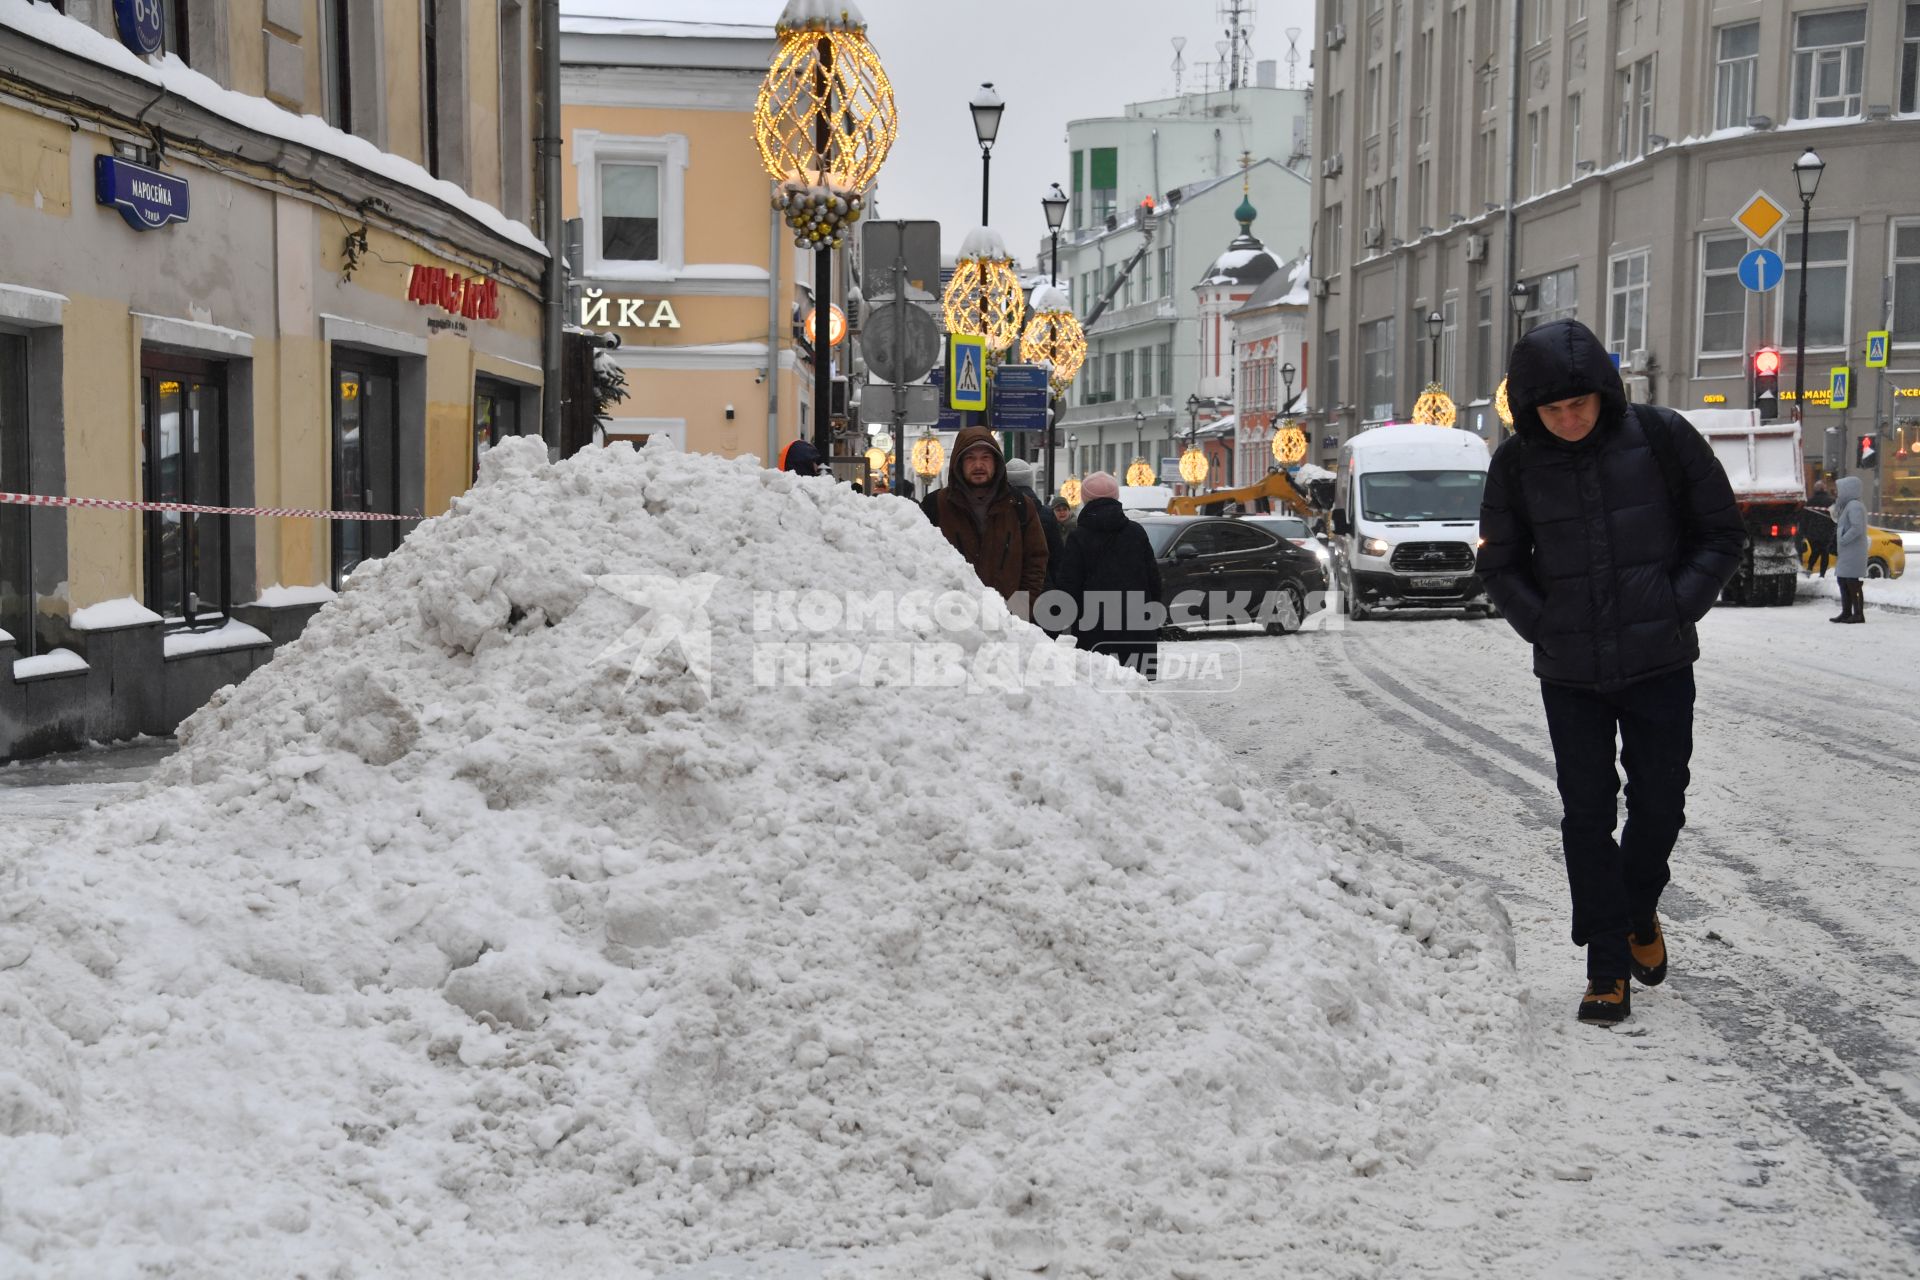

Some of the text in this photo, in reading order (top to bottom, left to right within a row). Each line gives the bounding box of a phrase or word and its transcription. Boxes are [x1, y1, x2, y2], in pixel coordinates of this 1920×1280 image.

[132, 179, 173, 206] МАРОСЕЙКА
[144, 208, 160, 222] УЛИЦА
[581, 287, 681, 328] ЙКА
